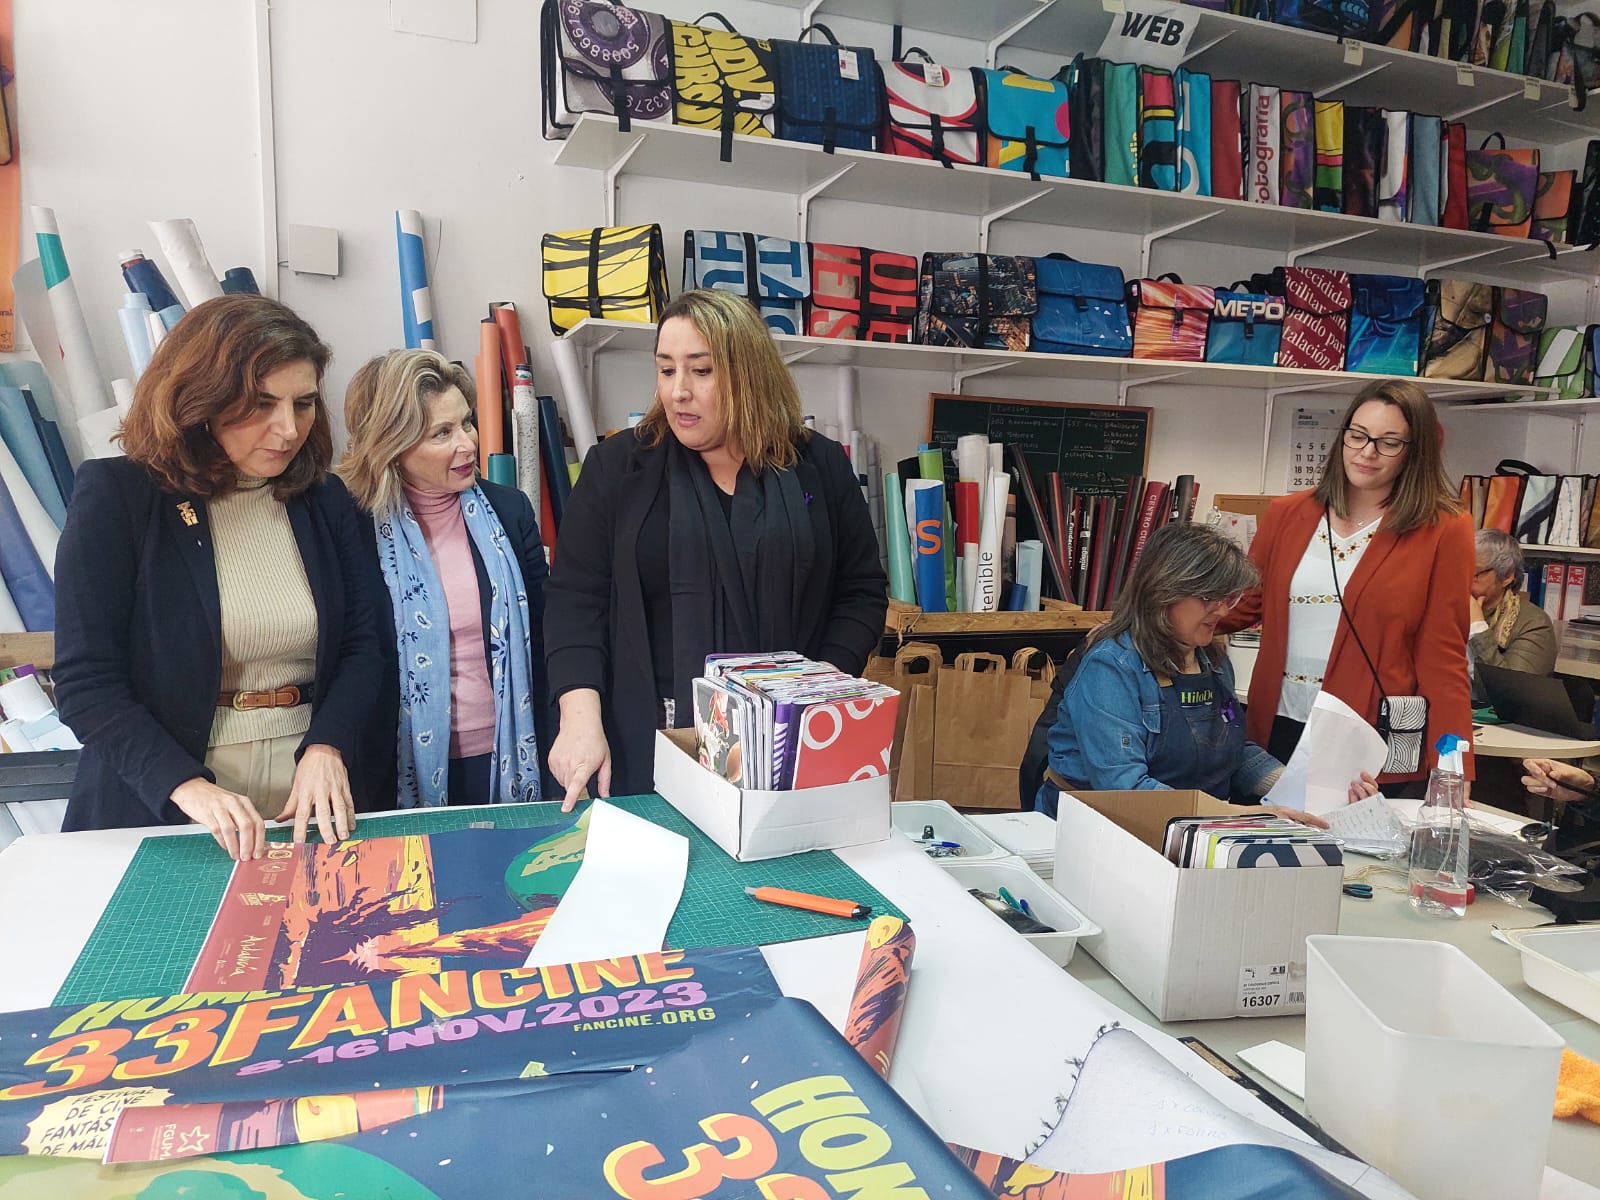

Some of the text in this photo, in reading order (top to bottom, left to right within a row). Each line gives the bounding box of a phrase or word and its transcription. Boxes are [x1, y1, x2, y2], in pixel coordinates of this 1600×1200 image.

[1120, 11, 1185, 47] WEB
[1308, 442, 1314, 450] 5
[1320, 442, 1326, 450] 6
[1295, 454, 1302, 462] 11
[1306, 454, 1314, 462] 12
[1294, 466, 1302, 474] 18
[1305, 466, 1314, 474] 19
[1293, 478, 1303, 486] 25
[1141, 494, 1157, 528] CENTRO
[916, 519, 942, 555] S
[1242, 995, 1281, 1008] 16307
[572, 1007, 716, 1032] FANCINE.ORG
[71, 1088, 154, 1105] FESTIVAL
[64, 1105, 92, 1121] DE
